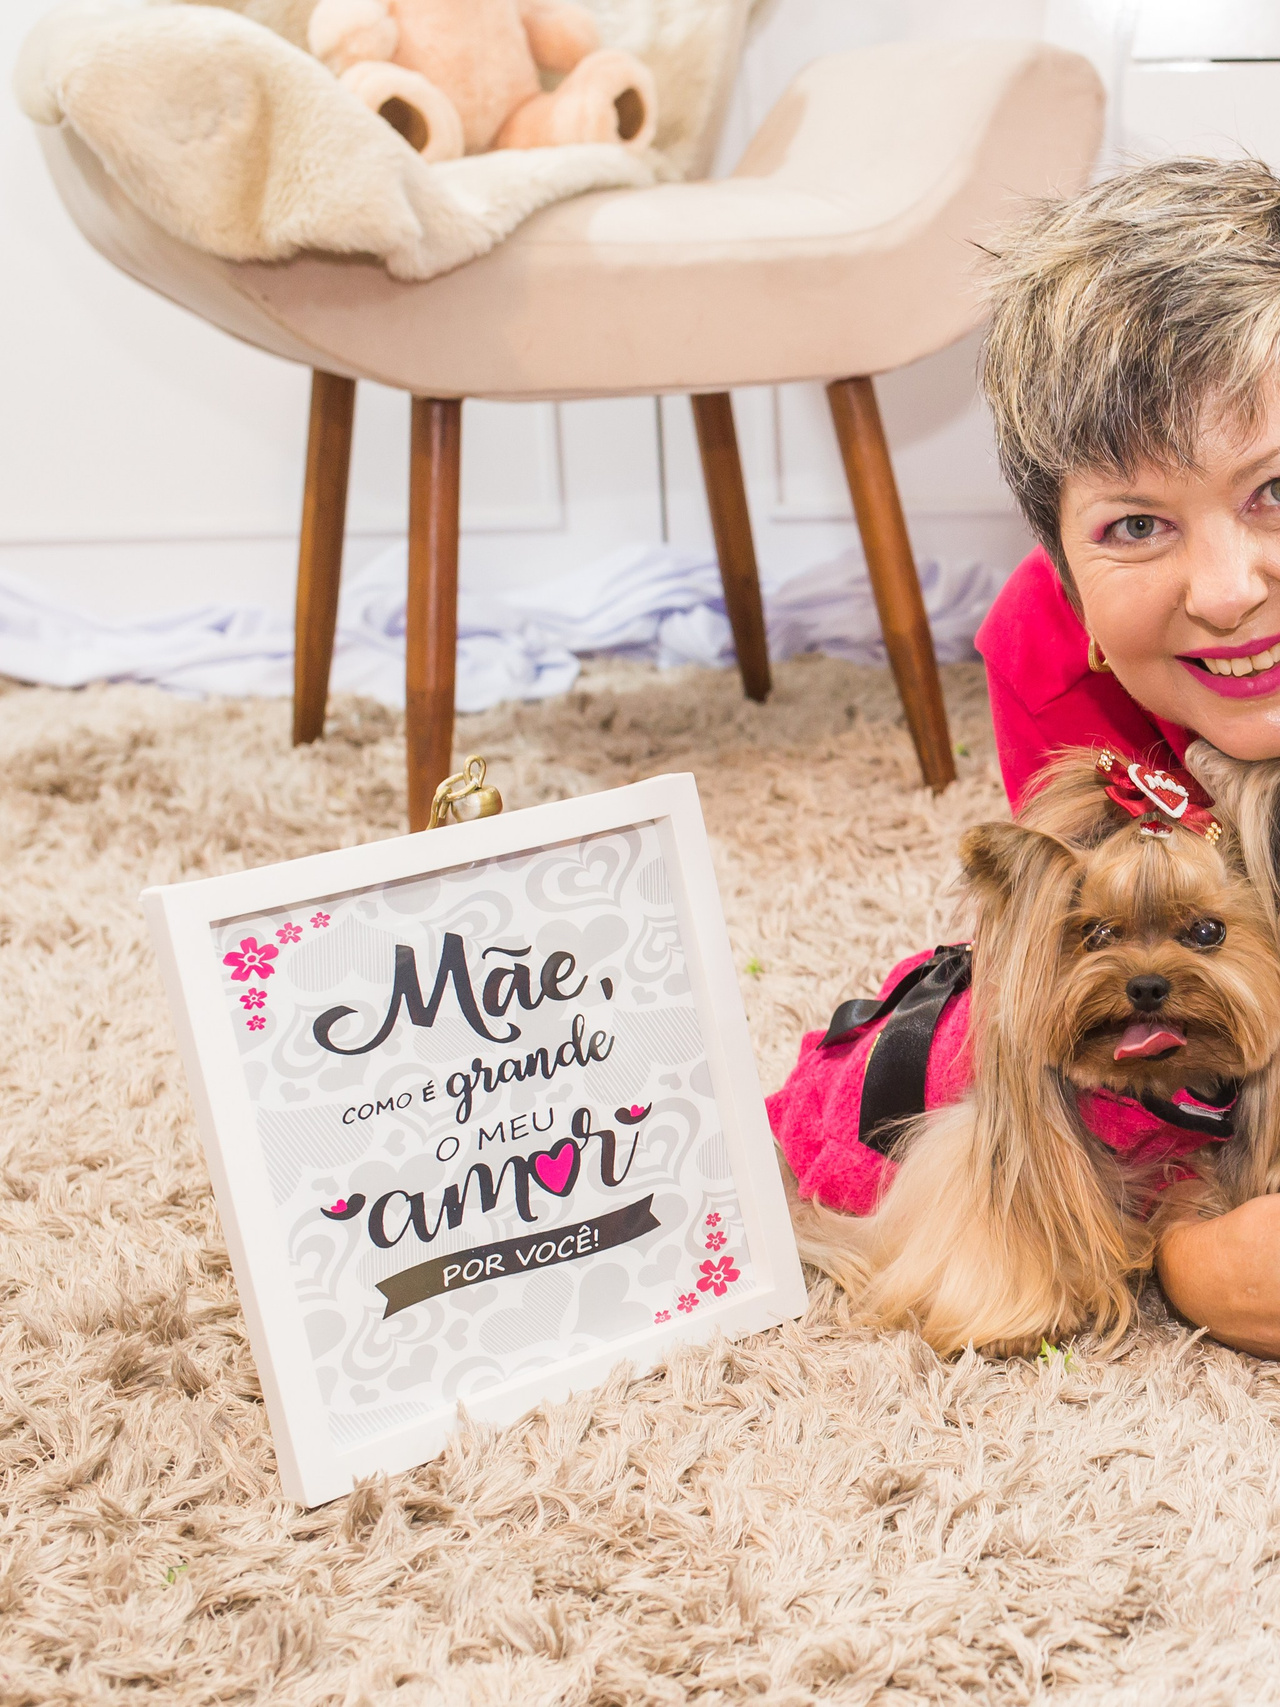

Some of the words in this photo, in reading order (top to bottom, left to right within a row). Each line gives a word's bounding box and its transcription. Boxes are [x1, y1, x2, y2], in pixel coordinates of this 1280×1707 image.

[313, 932, 613, 1055] Mãe,
[342, 1093, 413, 1125] COMO
[422, 1080, 436, 1102] É
[446, 1014, 615, 1125] grande
[436, 1137, 460, 1162] O
[478, 1107, 554, 1150] MEU
[443, 1254, 505, 1287] POR
[515, 1224, 600, 1267] VOCÊ!
